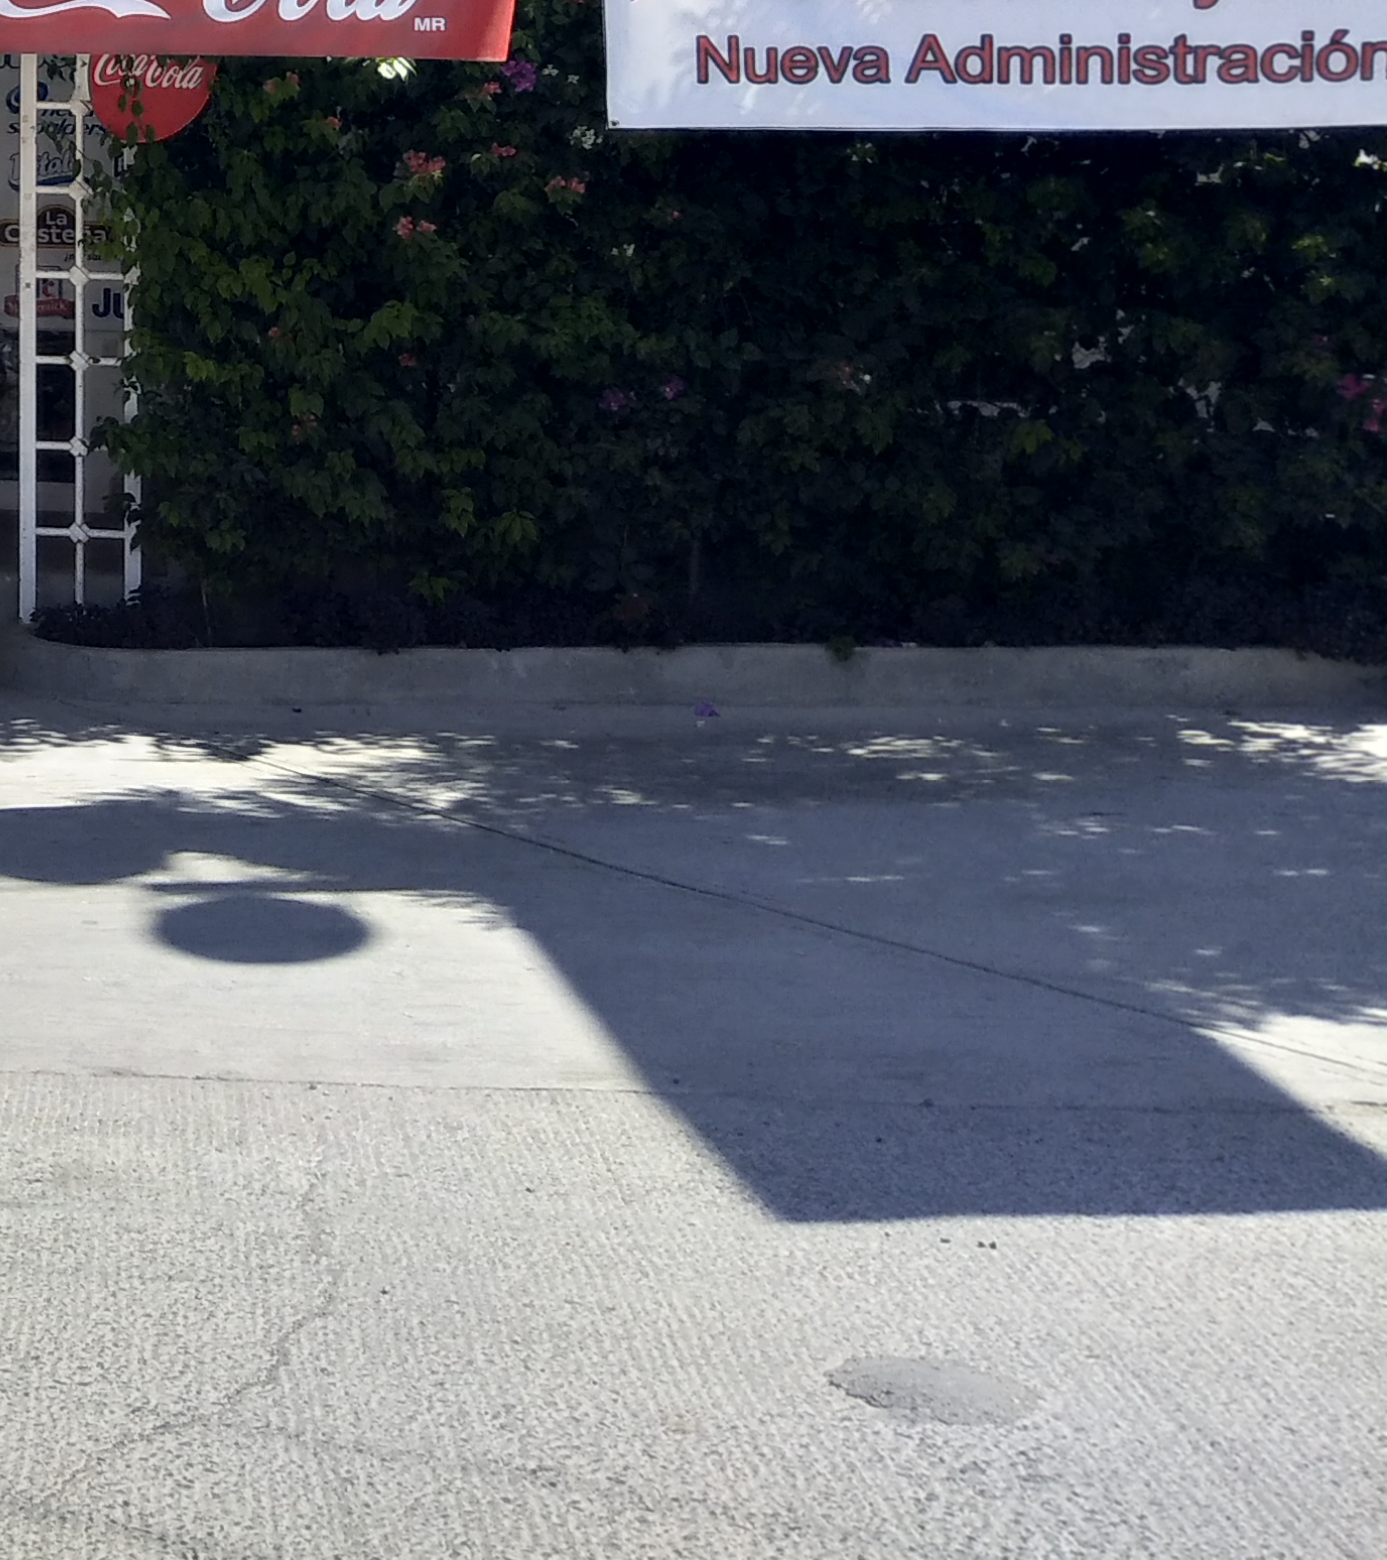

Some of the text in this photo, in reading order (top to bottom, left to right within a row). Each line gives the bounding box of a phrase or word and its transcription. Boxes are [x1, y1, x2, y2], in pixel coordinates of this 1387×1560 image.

[413, 16, 447, 32] MR
[695, 34, 892, 84] Nueva
[45, 211, 68, 226] La
